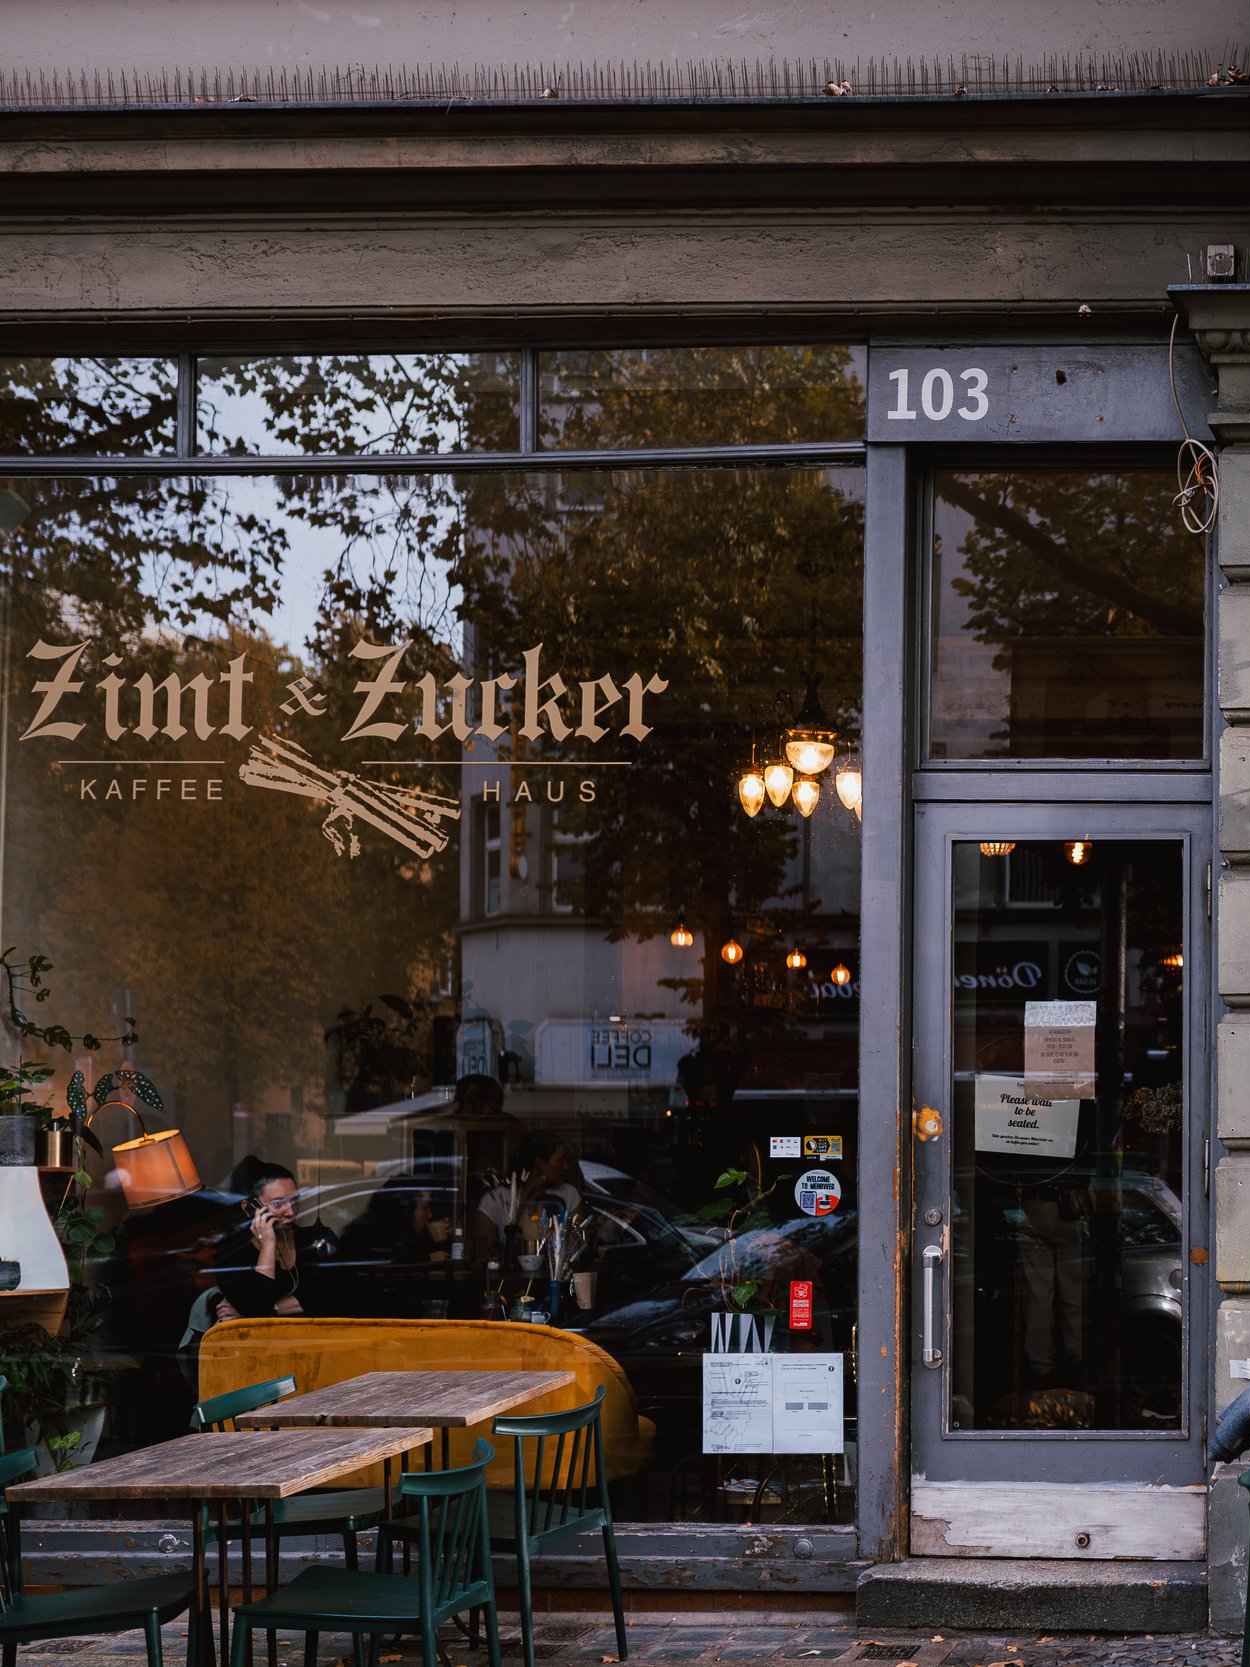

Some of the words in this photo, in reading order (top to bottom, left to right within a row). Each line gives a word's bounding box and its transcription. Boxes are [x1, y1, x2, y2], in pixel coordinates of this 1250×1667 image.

[887, 367, 989, 421] 103
[19, 638, 256, 742] Zimt
[279, 676, 328, 716] &
[340, 638, 669, 743] Zucker
[80, 779, 224, 801] KAFFEE
[482, 780, 597, 802] HAUS
[999, 1093, 1030, 1105] Please
[1014, 1106, 1024, 1115] to
[1025, 1106, 1036, 1116] be
[1007, 1119, 1039, 1129] seated.
